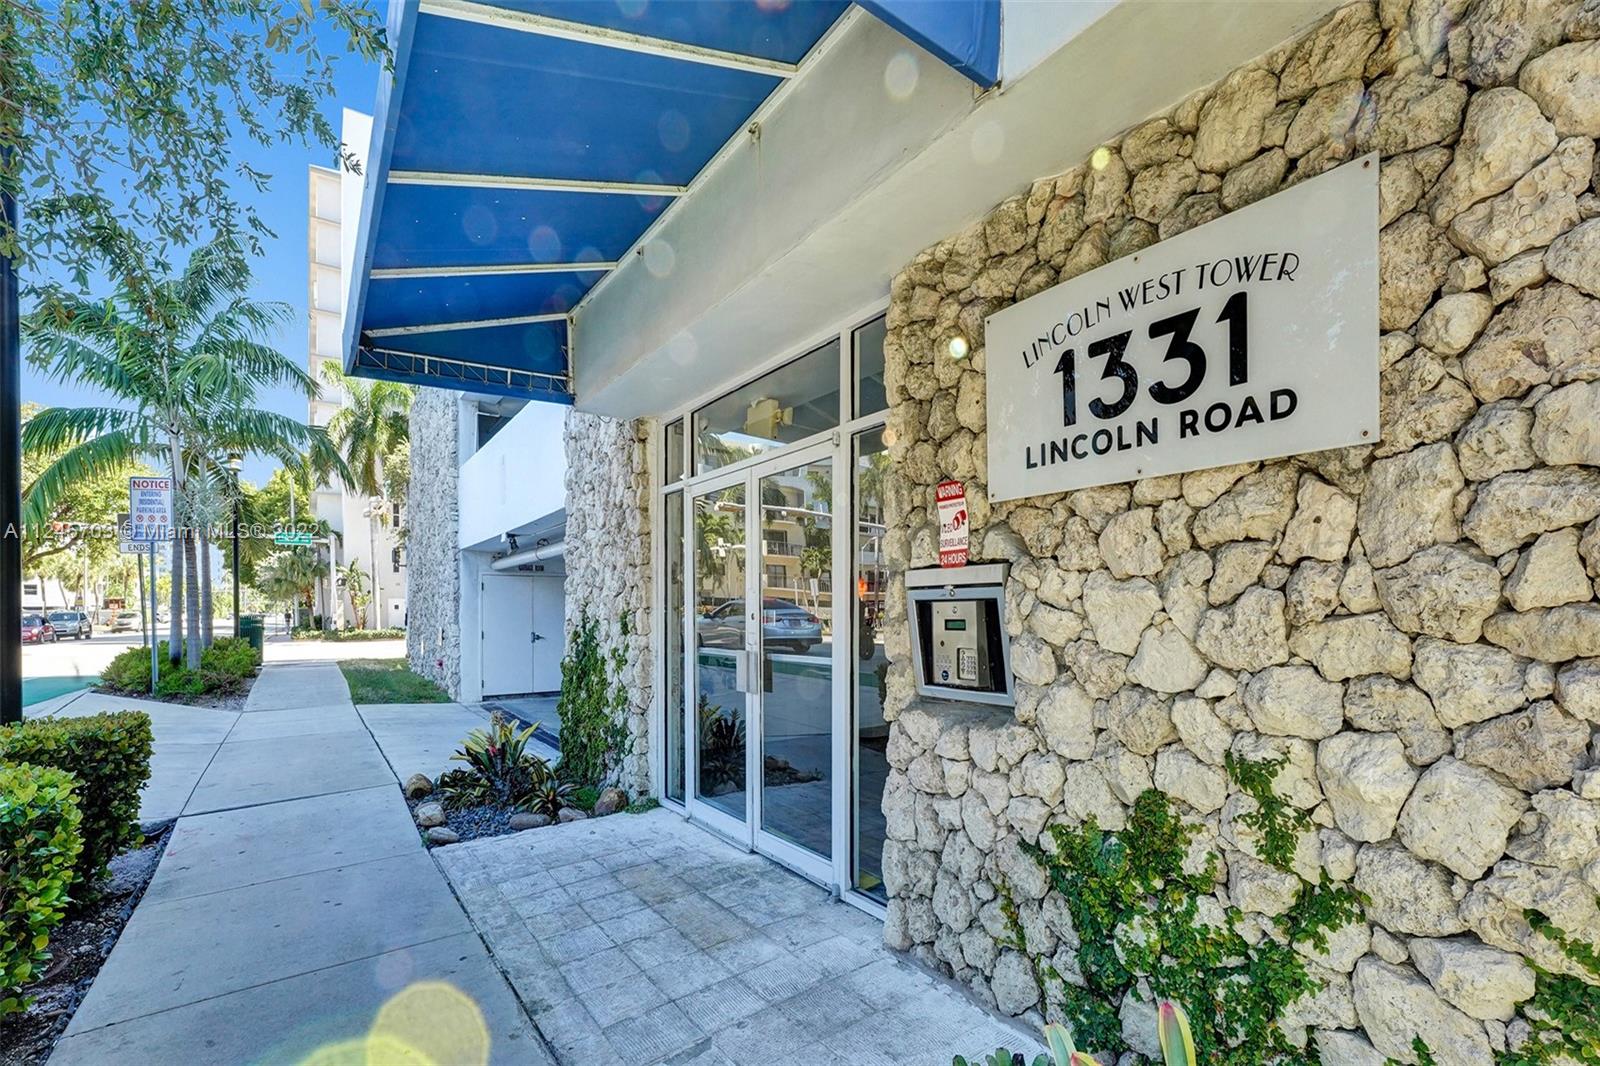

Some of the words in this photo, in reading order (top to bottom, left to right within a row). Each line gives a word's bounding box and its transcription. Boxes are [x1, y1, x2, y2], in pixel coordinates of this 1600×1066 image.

[1022, 297, 1111, 368] LINCOLN
[1119, 269, 1186, 312] WEST
[1197, 252, 1300, 292] TOWER
[1053, 291, 1248, 427] 1331
[1025, 417, 1159, 469] LINCOLN
[1179, 388, 1298, 439] ROAD
[133, 480, 169, 489] NOTICE
[937, 483, 963, 499] WARNING
[128, 543, 151, 552] ENDS
[940, 536, 968, 548] SURVEILLANCE
[947, 552, 966, 564] HOURS
